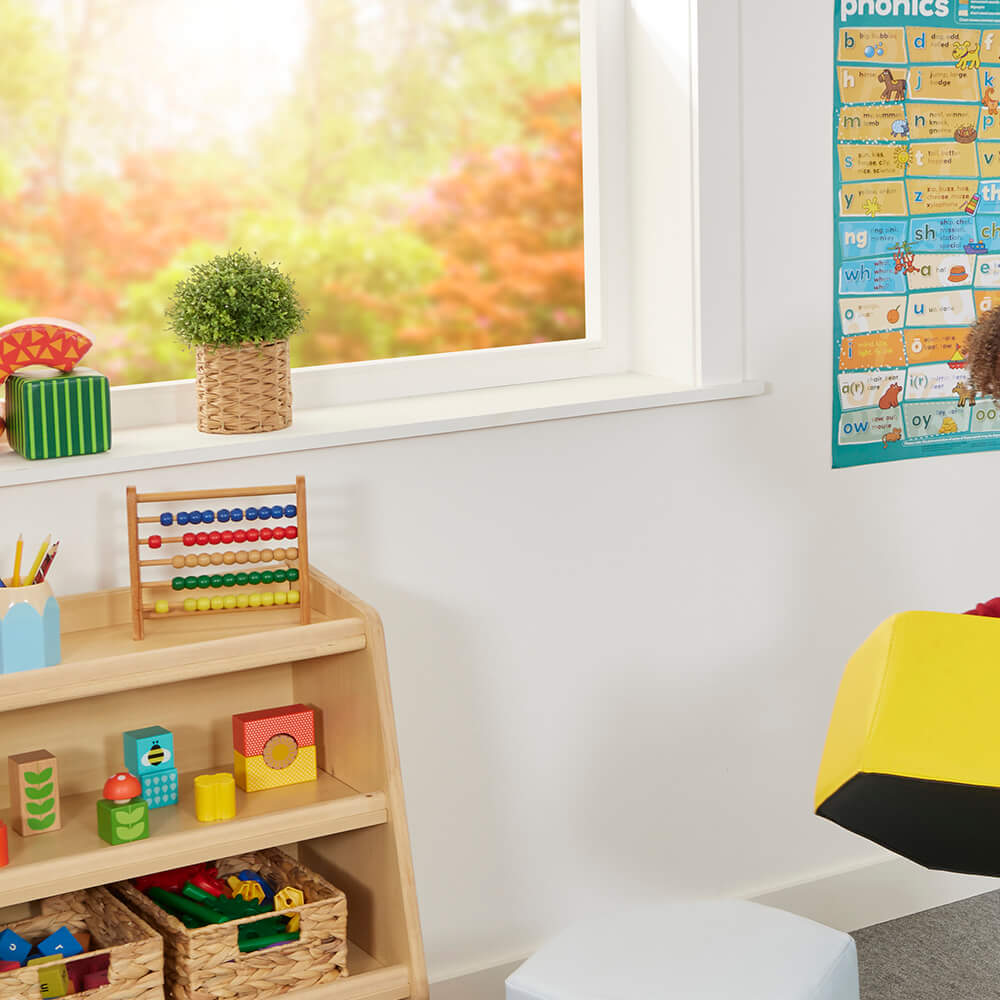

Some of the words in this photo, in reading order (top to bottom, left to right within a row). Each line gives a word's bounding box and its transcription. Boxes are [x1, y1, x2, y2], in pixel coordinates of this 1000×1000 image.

[841, 0, 949, 22] phonics
[844, 32, 855, 48] b
[914, 32, 925, 48] d
[984, 33, 994, 50] f
[843, 70, 855, 88] h
[915, 71, 922, 90] j
[984, 71, 994, 87] k
[843, 116, 861, 128] m
[914, 115, 925, 126] n
[983, 114, 994, 130] p
[844, 156, 854, 168] s
[915, 150, 924, 166] t
[984, 153, 994, 164] v
[844, 194, 853, 209] y
[914, 191, 923, 202] z
[845, 230, 867, 248] ng
[915, 224, 935, 240] sh
[845, 265, 870, 280] wh
[920, 265, 931, 276] a
[980, 263, 991, 274] e
[845, 309, 854, 320] o
[914, 303, 924, 314] u
[912, 415, 931, 430] oy
[975, 409, 996, 421] oo
[843, 421, 868, 434] ow
